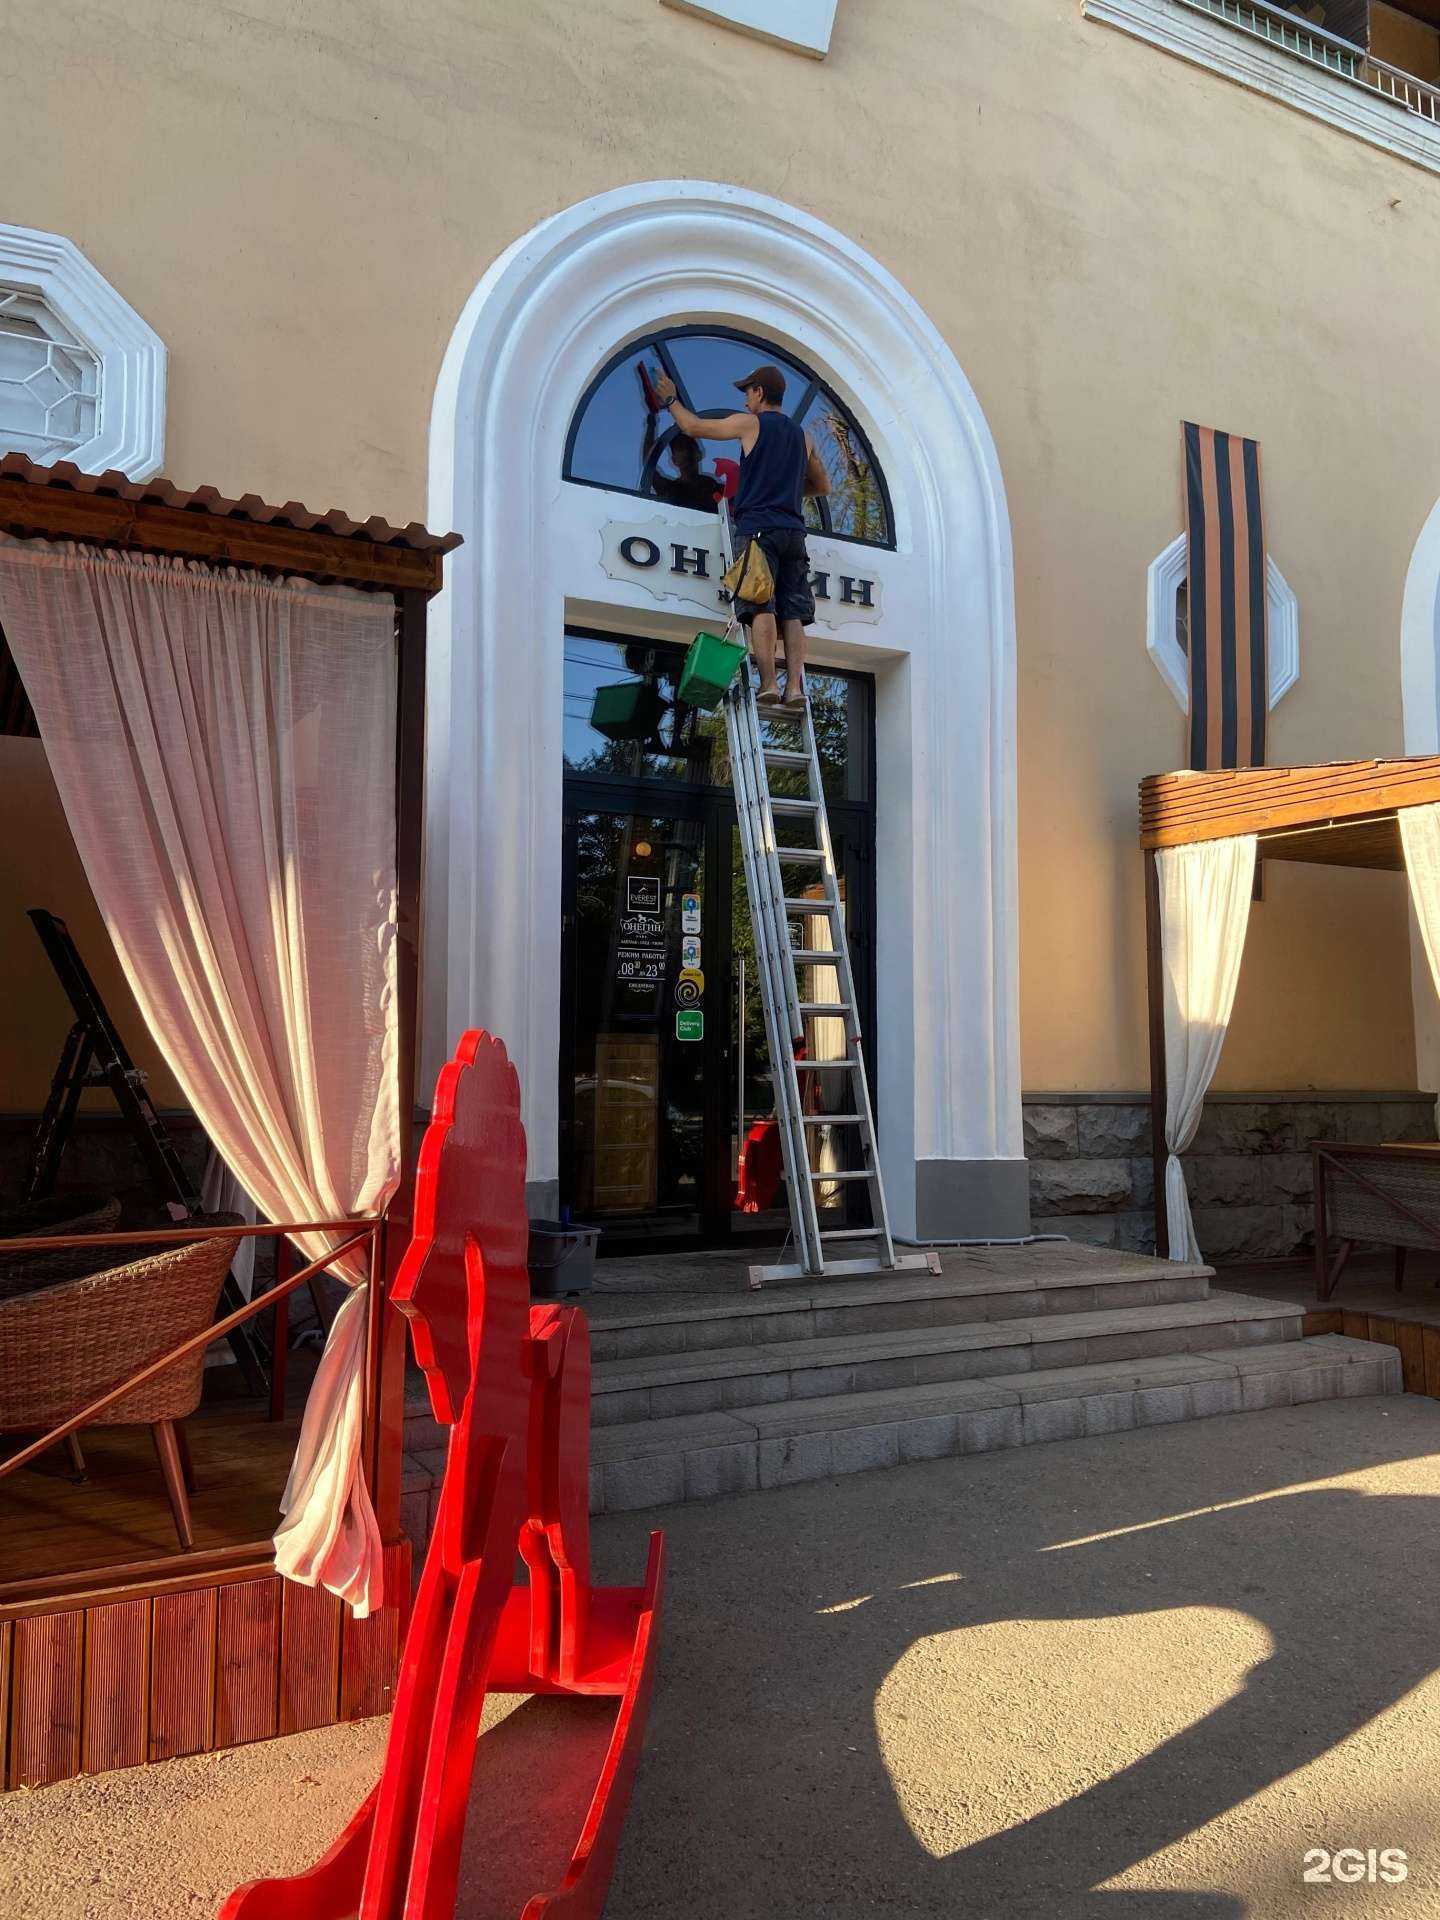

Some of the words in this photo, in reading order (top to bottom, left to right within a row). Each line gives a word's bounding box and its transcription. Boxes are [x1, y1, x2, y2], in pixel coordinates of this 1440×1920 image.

[620, 536, 874, 607] ОНИН
[630, 893, 656, 902] EVEREST
[623, 922, 661, 932] ОНЕГИН
[617, 951, 640, 959] РЕЖИМ
[641, 952, 665, 960] РАБОТЫ
[679, 1020, 700, 1028] Delivery
